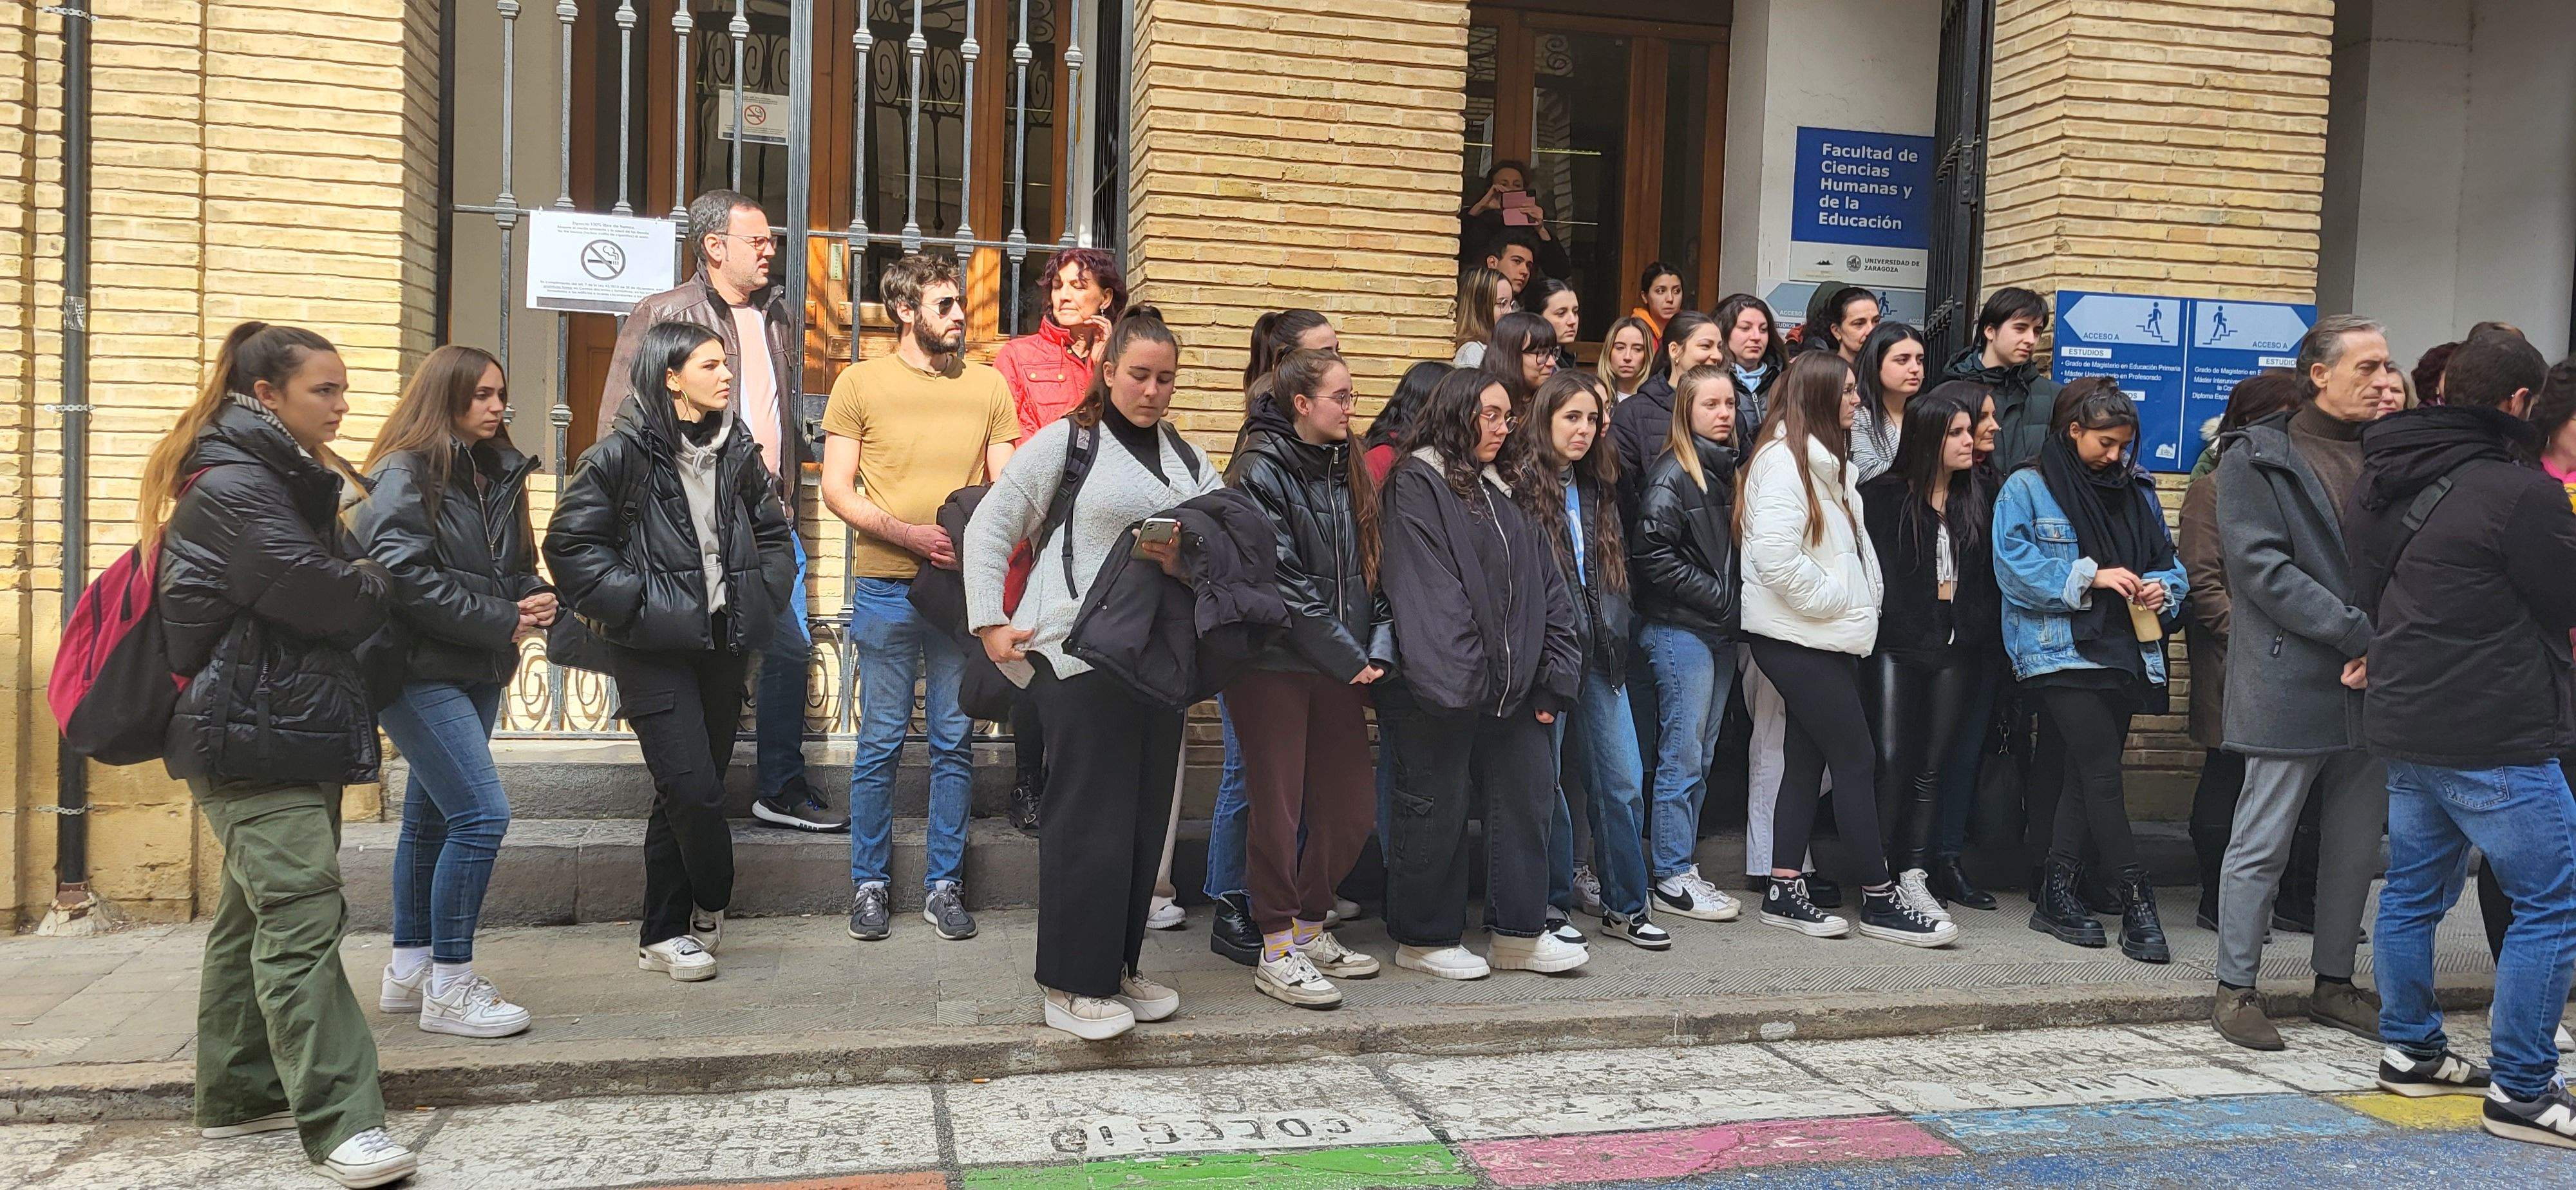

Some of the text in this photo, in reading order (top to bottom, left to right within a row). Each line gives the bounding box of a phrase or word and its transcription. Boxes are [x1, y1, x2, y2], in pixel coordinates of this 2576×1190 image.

[1822, 143, 1918, 163] Facultad de
[1821, 160, 1890, 178] Ciencias
[1820, 177, 1913, 199] Humanas y
[1819, 194, 1859, 210] de la
[1819, 212, 1902, 230] Educación
[1864, 258, 1910, 267] UNIVERSIDAD
[2092, 361, 2119, 370] Magisterio
